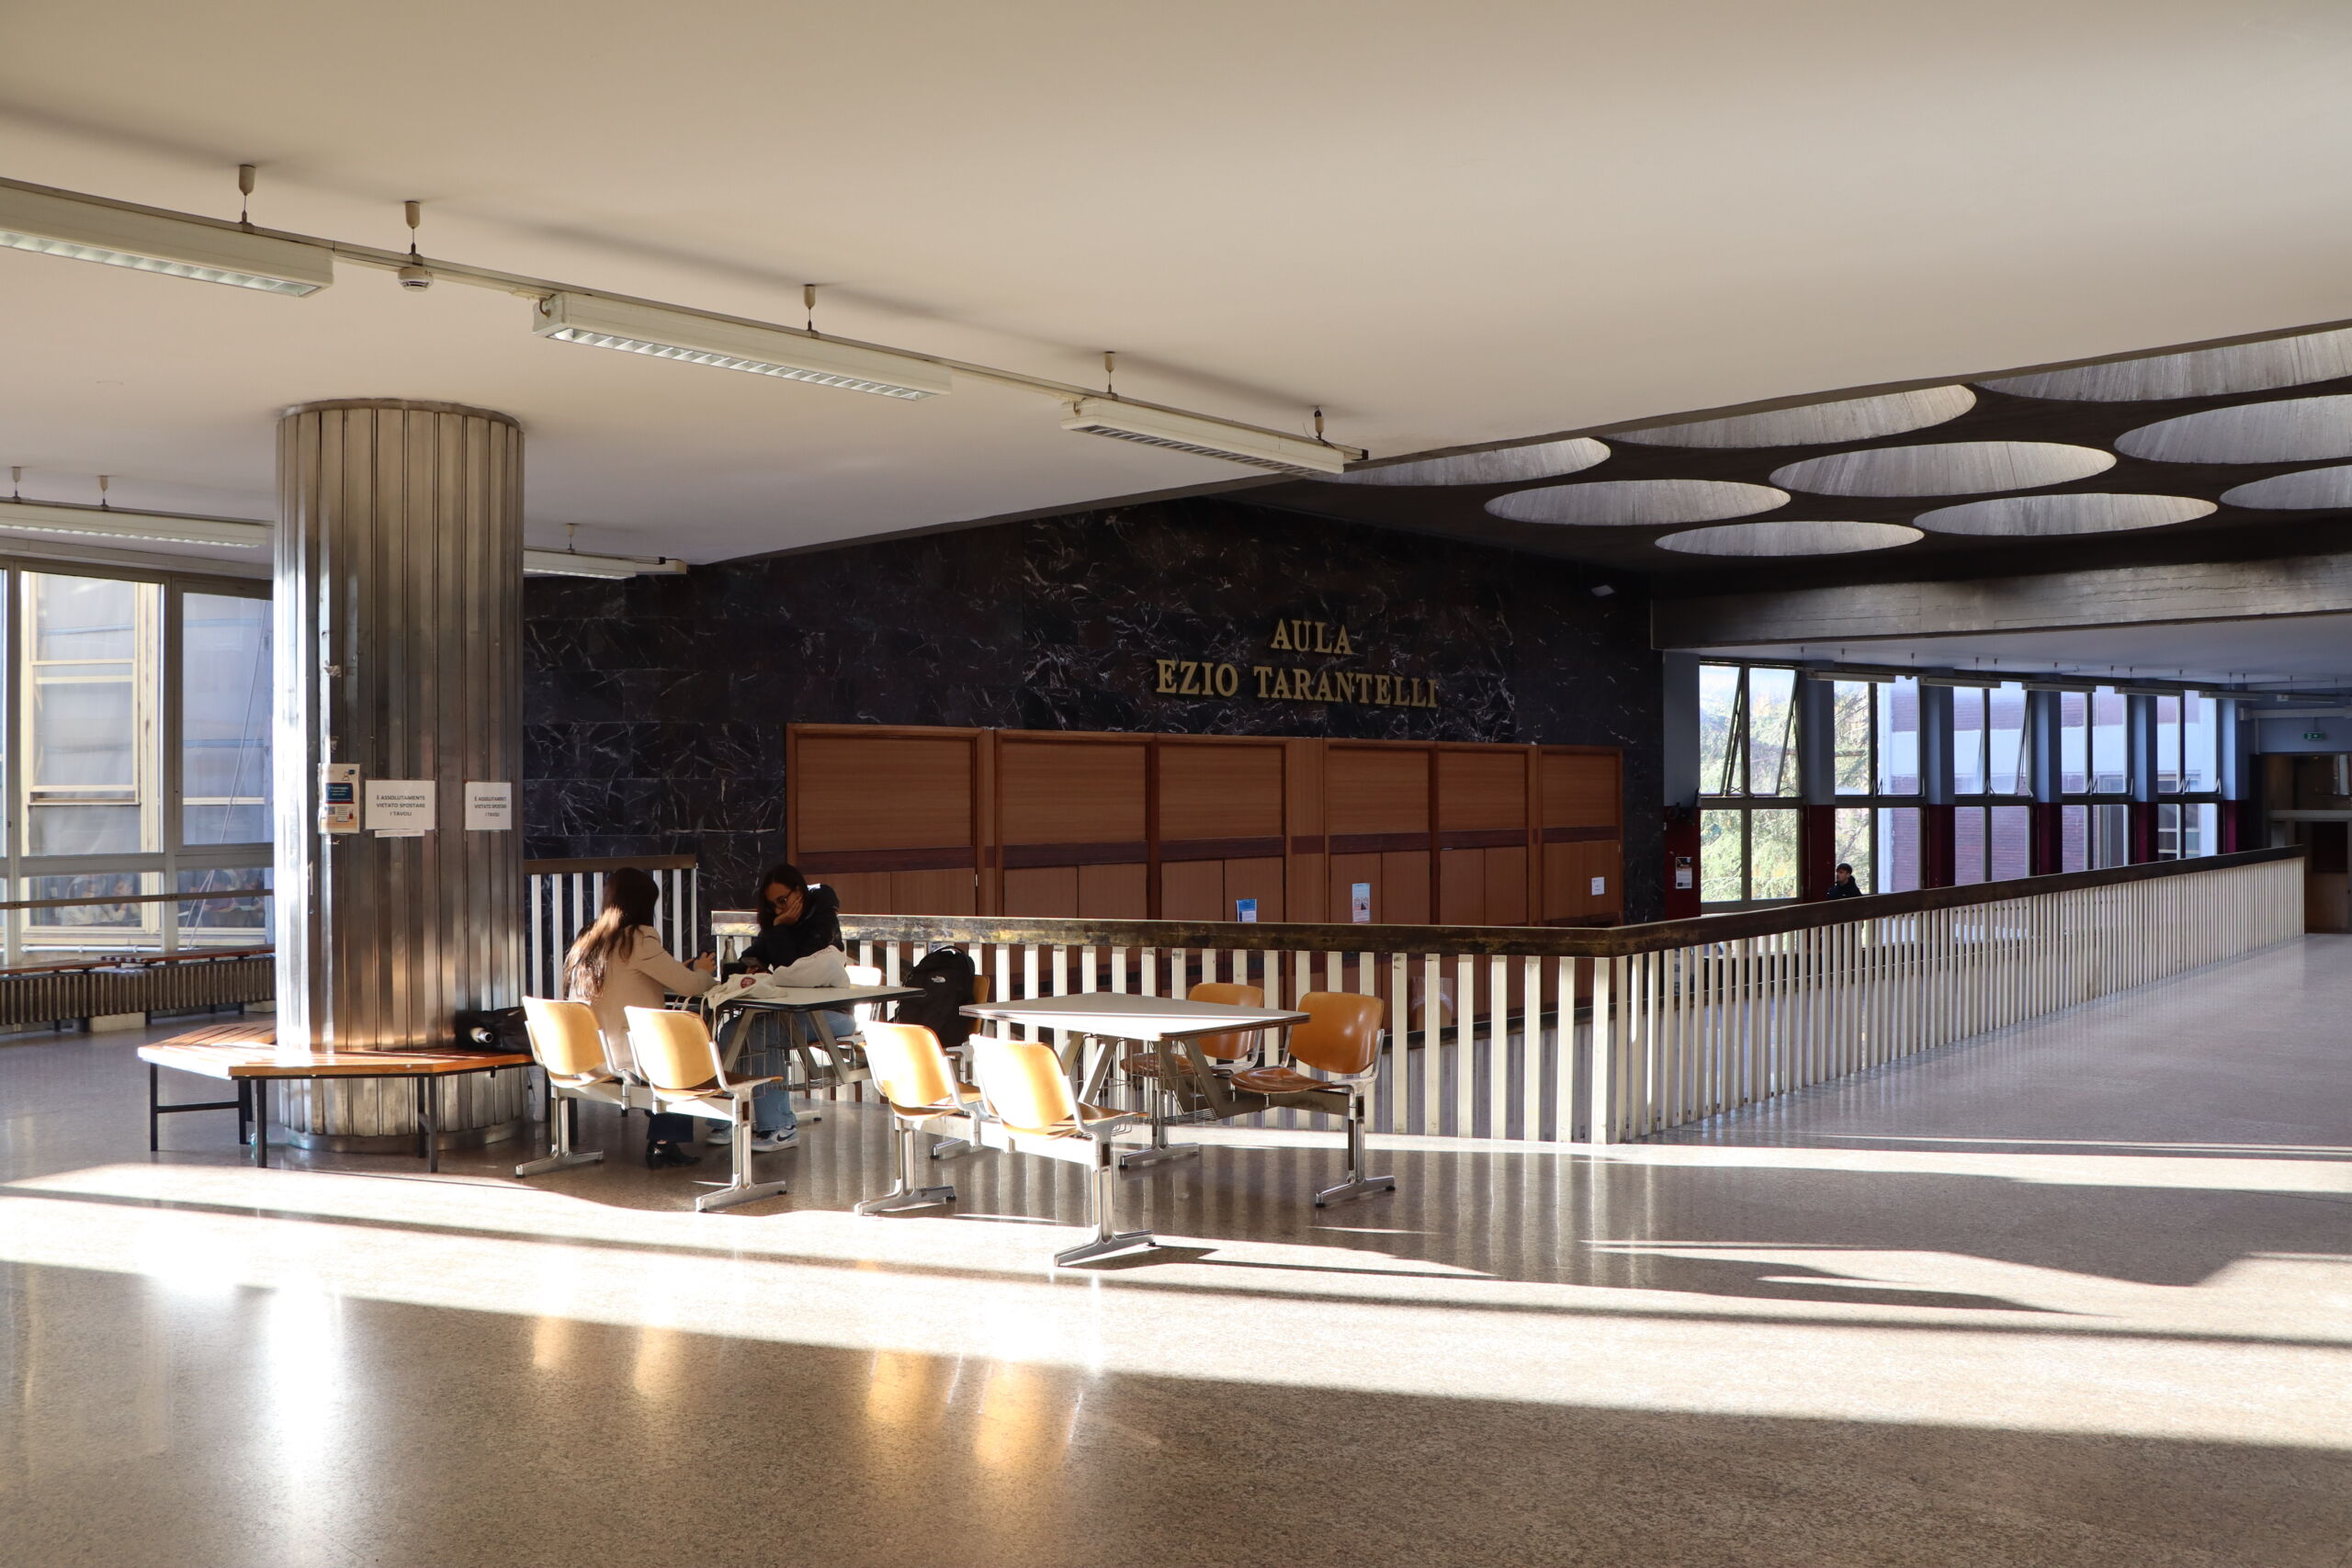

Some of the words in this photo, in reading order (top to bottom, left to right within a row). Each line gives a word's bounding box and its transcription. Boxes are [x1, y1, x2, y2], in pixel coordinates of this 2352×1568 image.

[1271, 617, 1353, 655] AULA
[1156, 659, 1238, 697] EZIO
[1253, 666, 1439, 708] TARANTELLI
